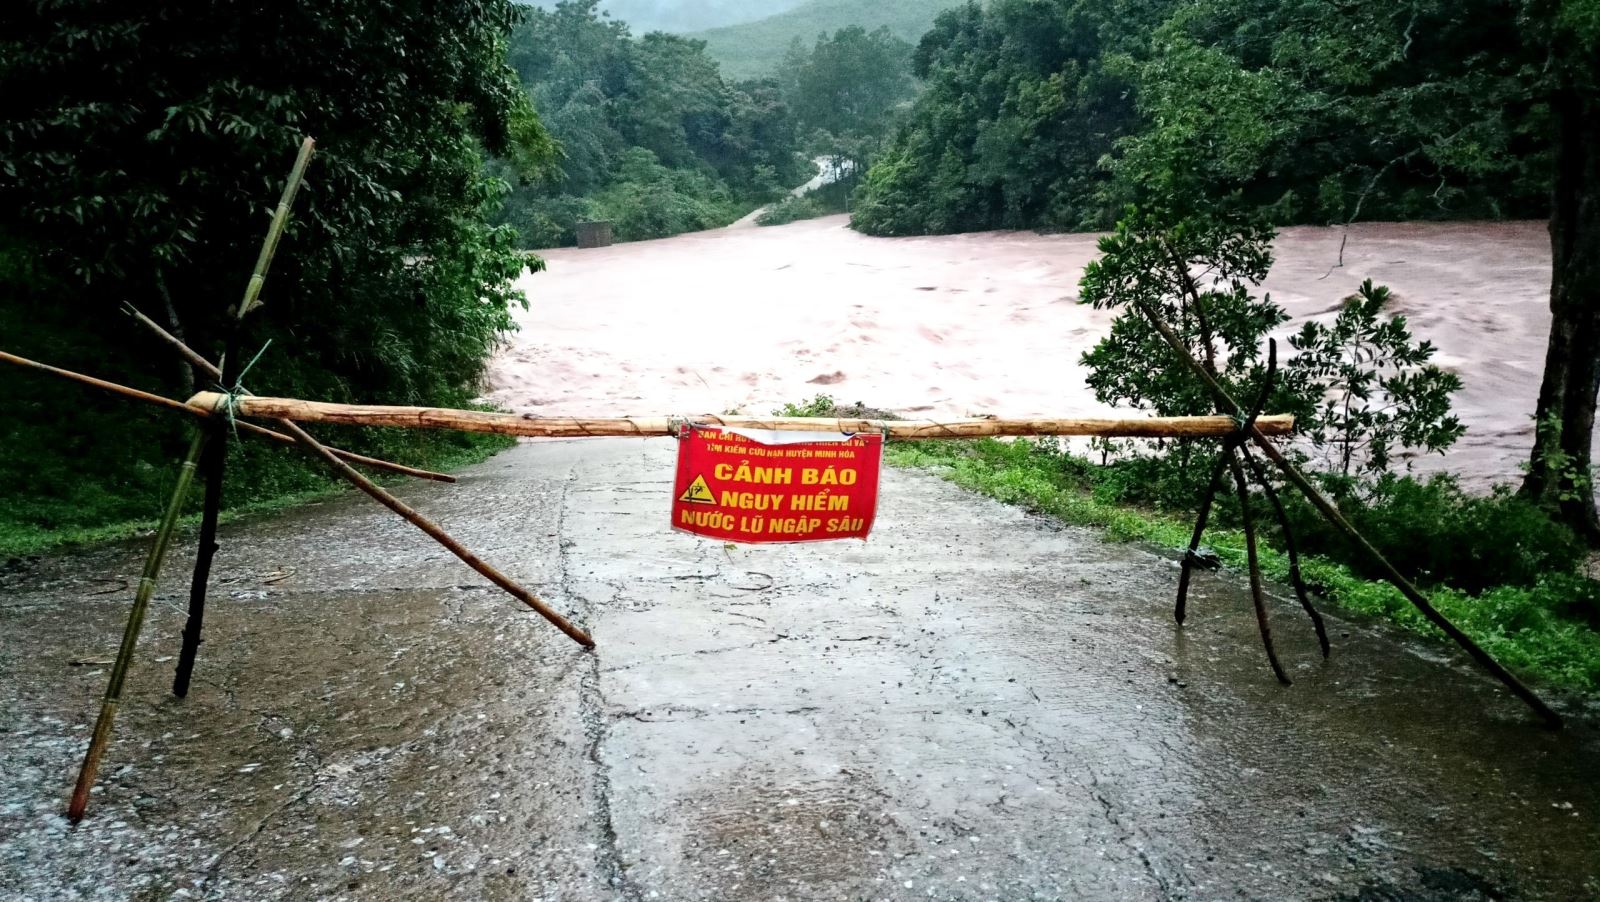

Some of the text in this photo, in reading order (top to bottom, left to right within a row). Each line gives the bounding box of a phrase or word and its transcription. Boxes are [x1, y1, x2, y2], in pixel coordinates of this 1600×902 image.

[724, 443, 746, 455] KIẾM
[786, 448, 813, 460] HUYỆN
[815, 450, 836, 458] MINH
[714, 460, 857, 486] CẢNH BÁO
[720, 488, 849, 511] NGUY HIỂM
[681, 509, 864, 537] NƯỚC LŨ NGẬP SÂU
